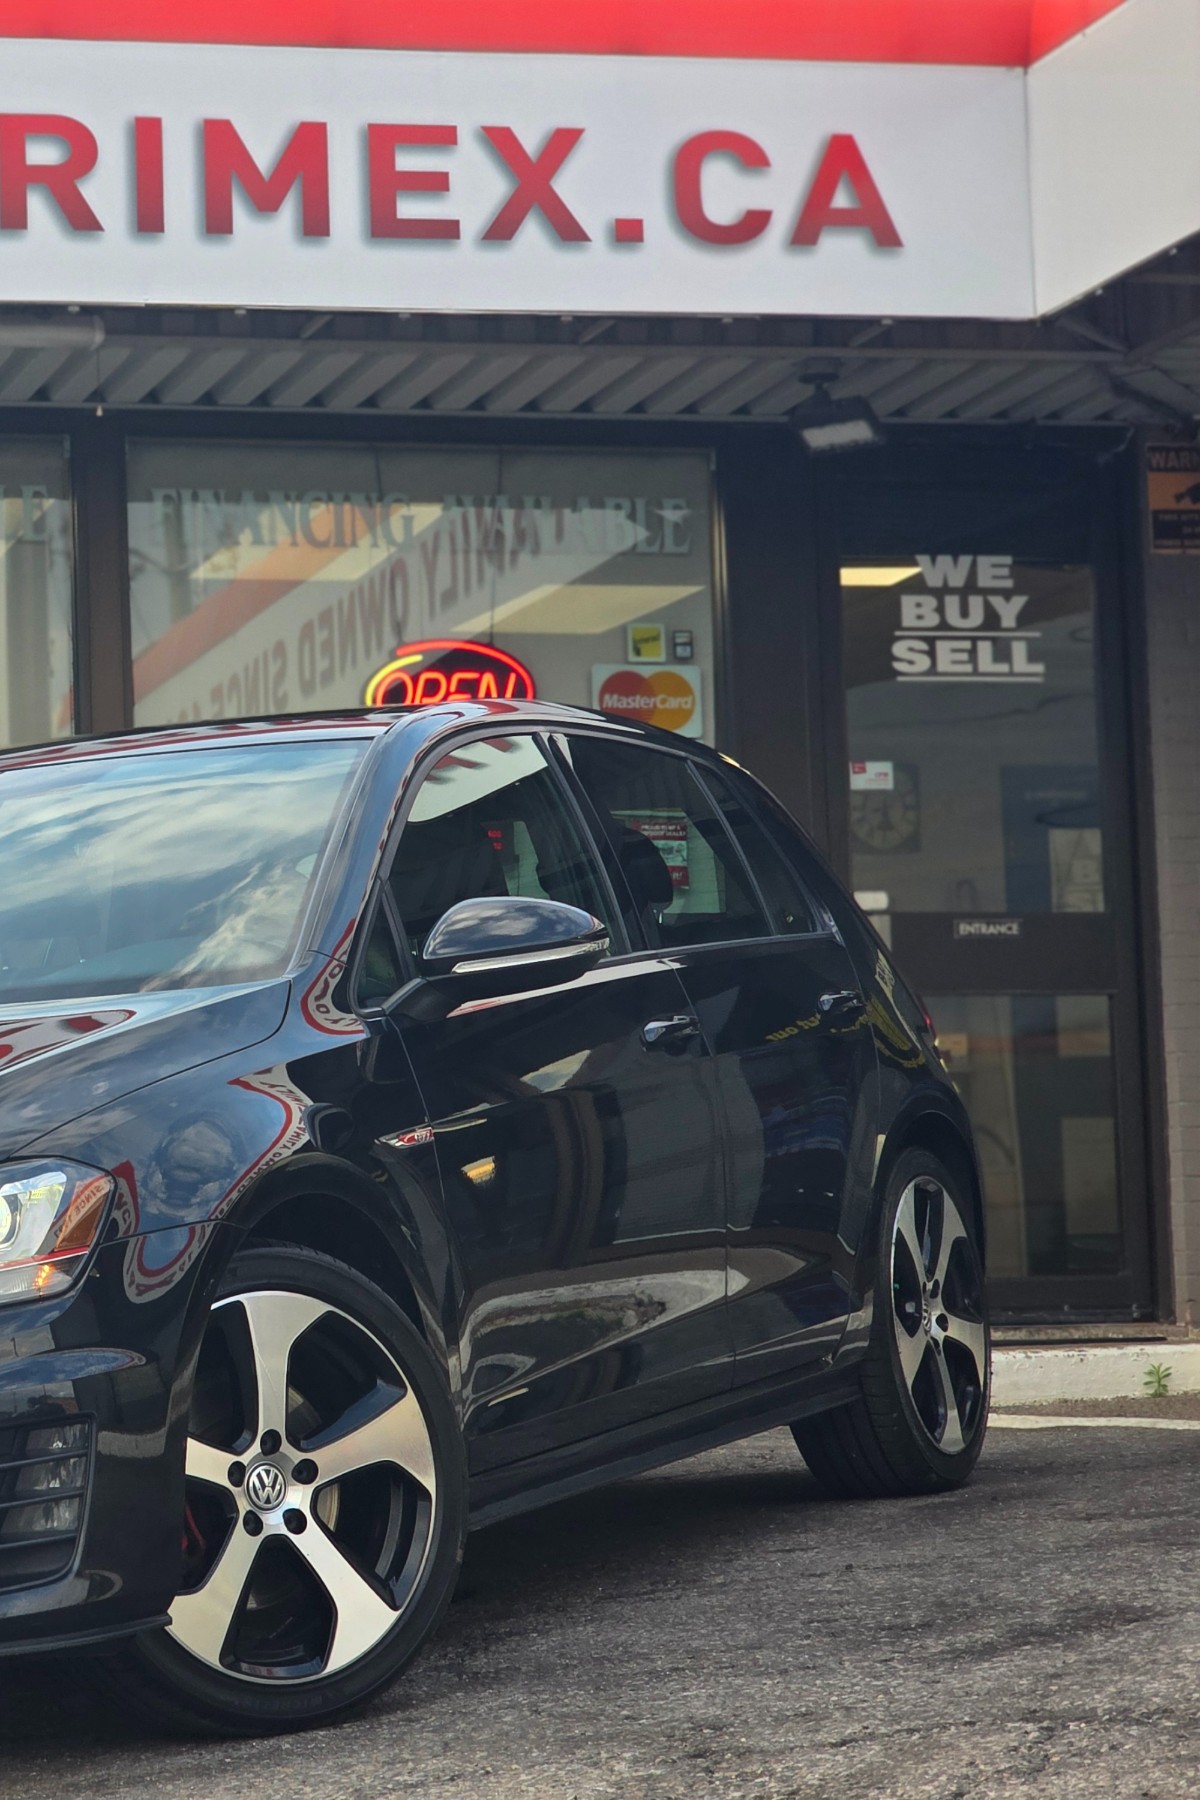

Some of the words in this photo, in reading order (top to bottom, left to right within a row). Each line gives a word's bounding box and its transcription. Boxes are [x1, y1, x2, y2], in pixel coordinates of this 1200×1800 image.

[152, 488, 415, 551] FINANCING
[438, 494, 691, 554] AVAILABLE
[915, 555, 1013, 589] WE
[900, 596, 1028, 629] BUY
[891, 638, 1045, 674] SELL
[375, 669, 518, 706] OPEN
[603, 693, 693, 710] MasterCard
[959, 922, 1020, 936] ENTRANCE
